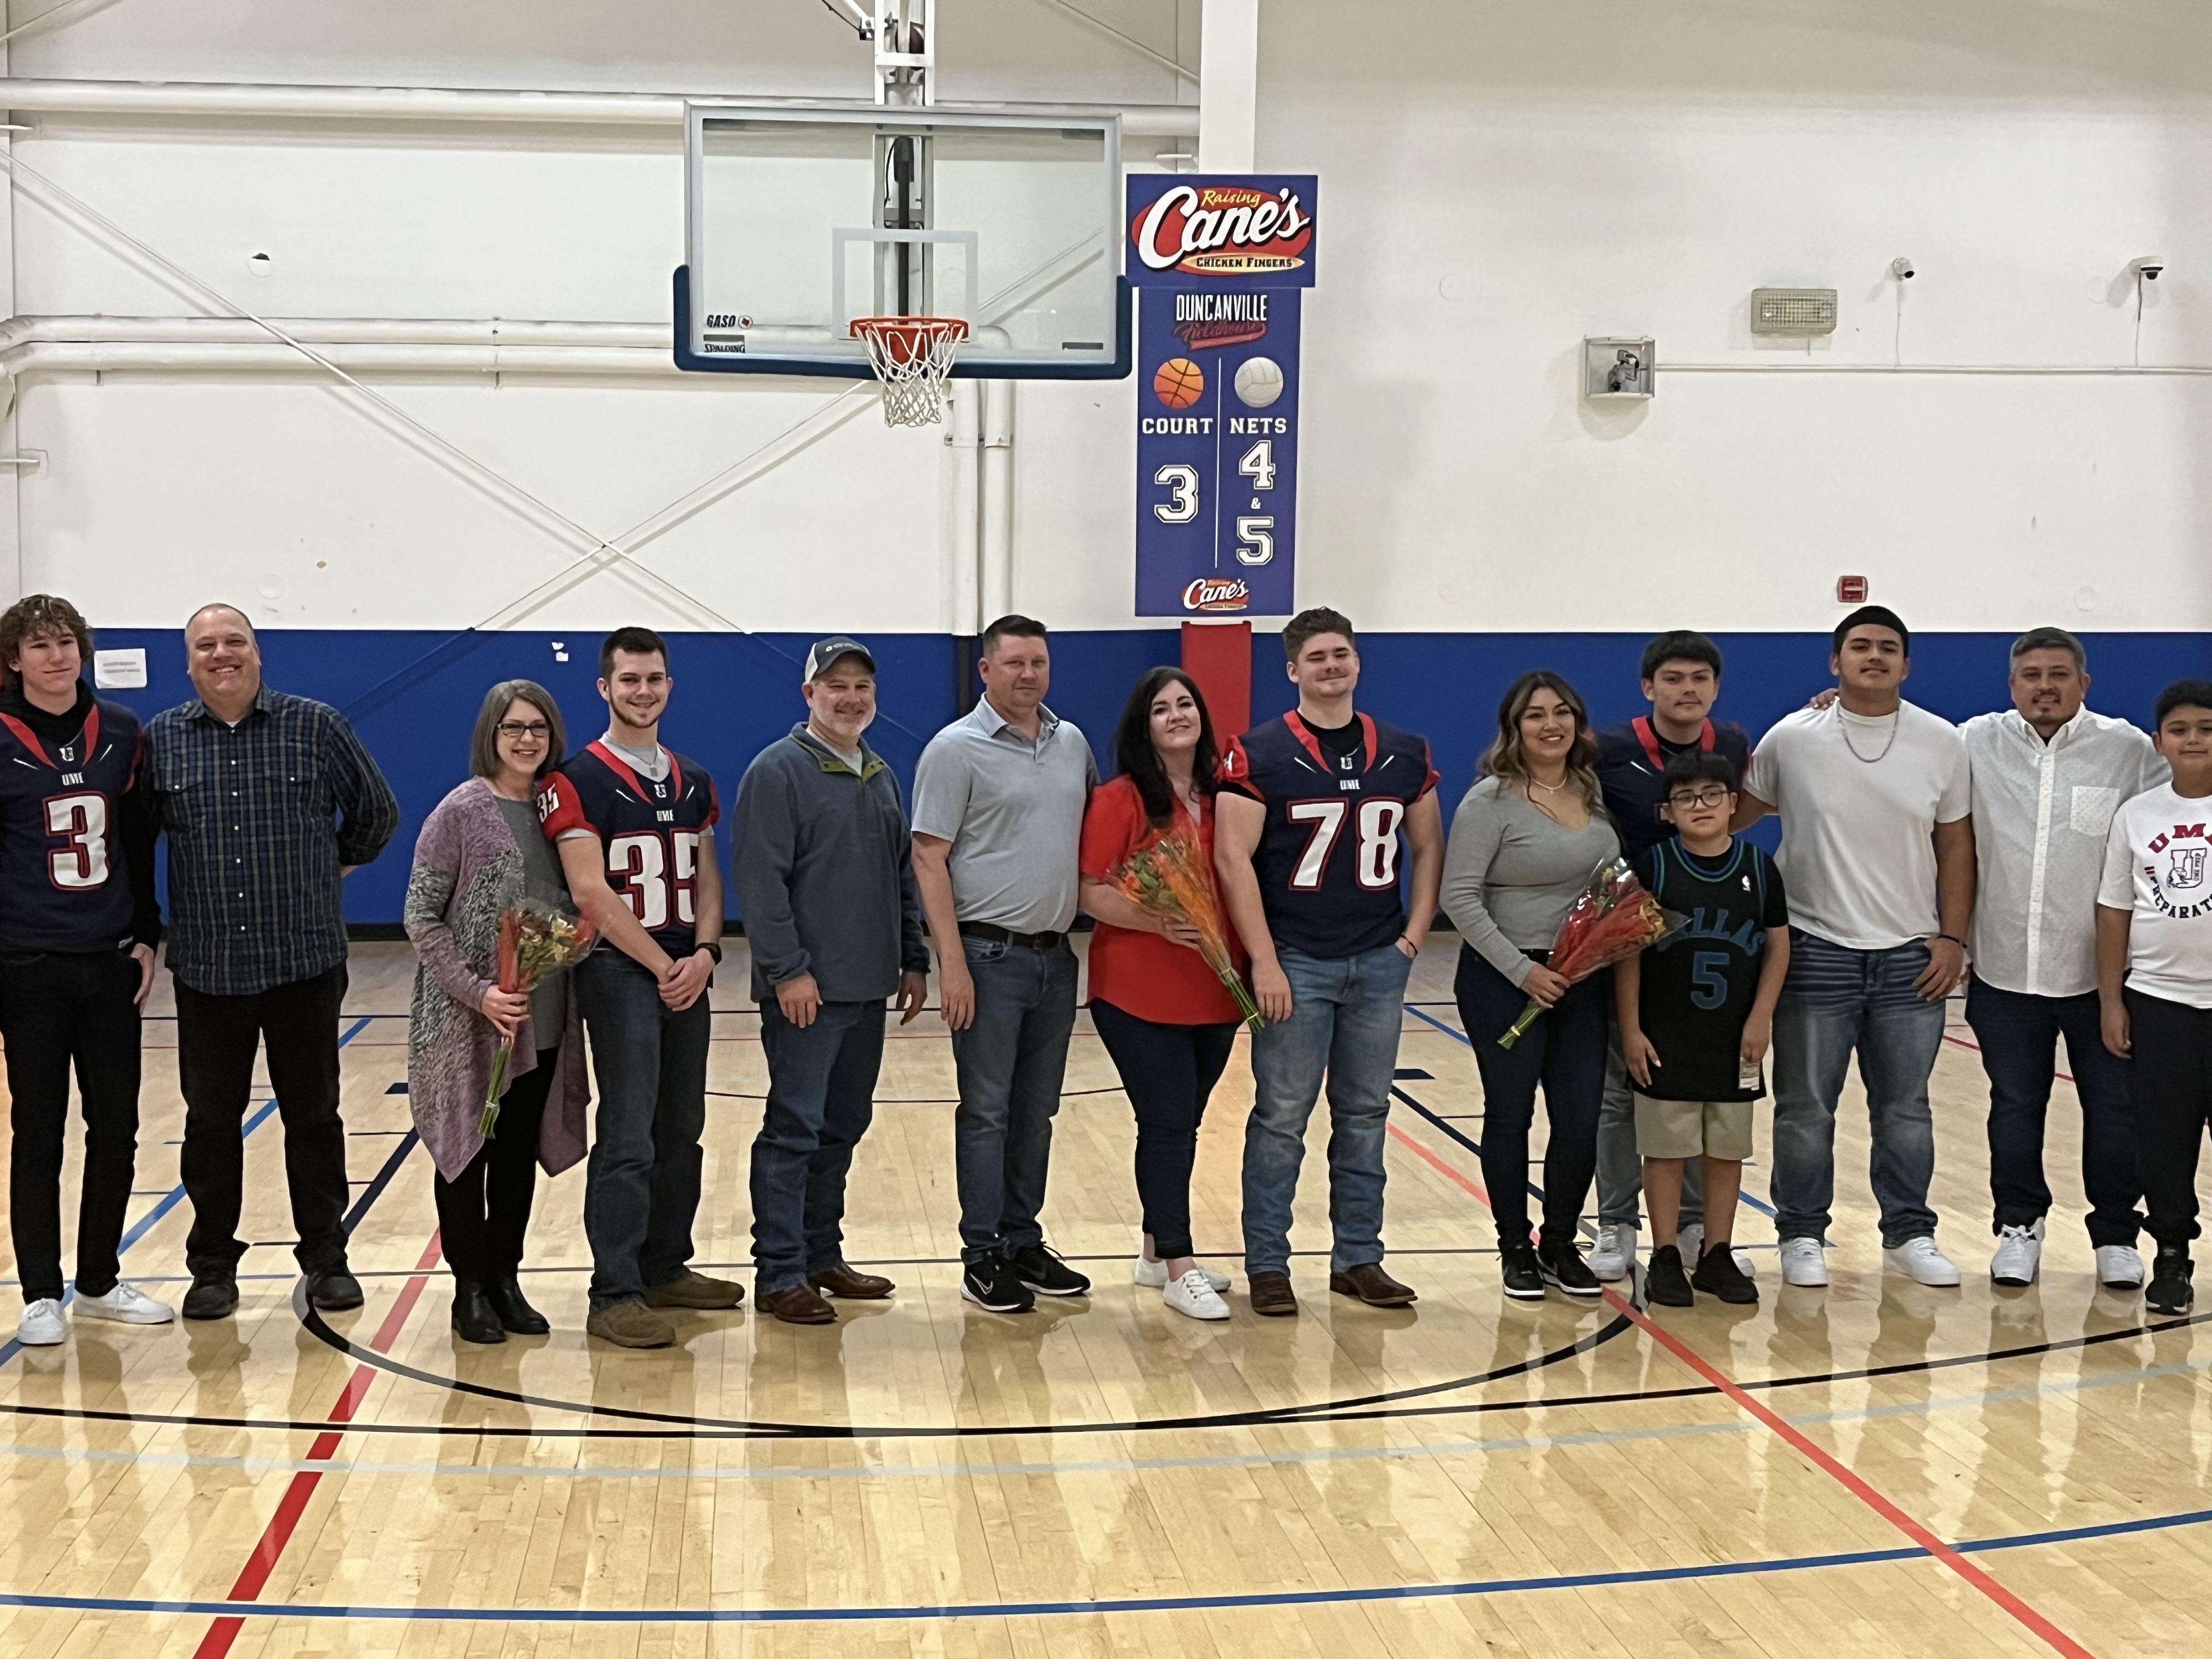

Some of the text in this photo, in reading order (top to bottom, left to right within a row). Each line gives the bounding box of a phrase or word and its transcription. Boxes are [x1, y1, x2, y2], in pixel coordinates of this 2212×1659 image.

[1201, 190, 1261, 207] Raising
[1138, 185, 1311, 269] Cane's
[1176, 294, 1268, 321] DUNCANVILLE
[1142, 417, 1214, 435] COURT
[1229, 417, 1287, 435] NETS
[1239, 439, 1276, 490] 4
[1154, 464, 1199, 523] 3
[1250, 497, 1261, 510] &
[1236, 516, 1274, 566] 5
[1183, 578, 1249, 610] Cane's
[537, 782, 560, 823] 35
[42, 791, 111, 891] 3
[1286, 796, 1404, 892] 78
[1690, 951, 1730, 1010] 5
